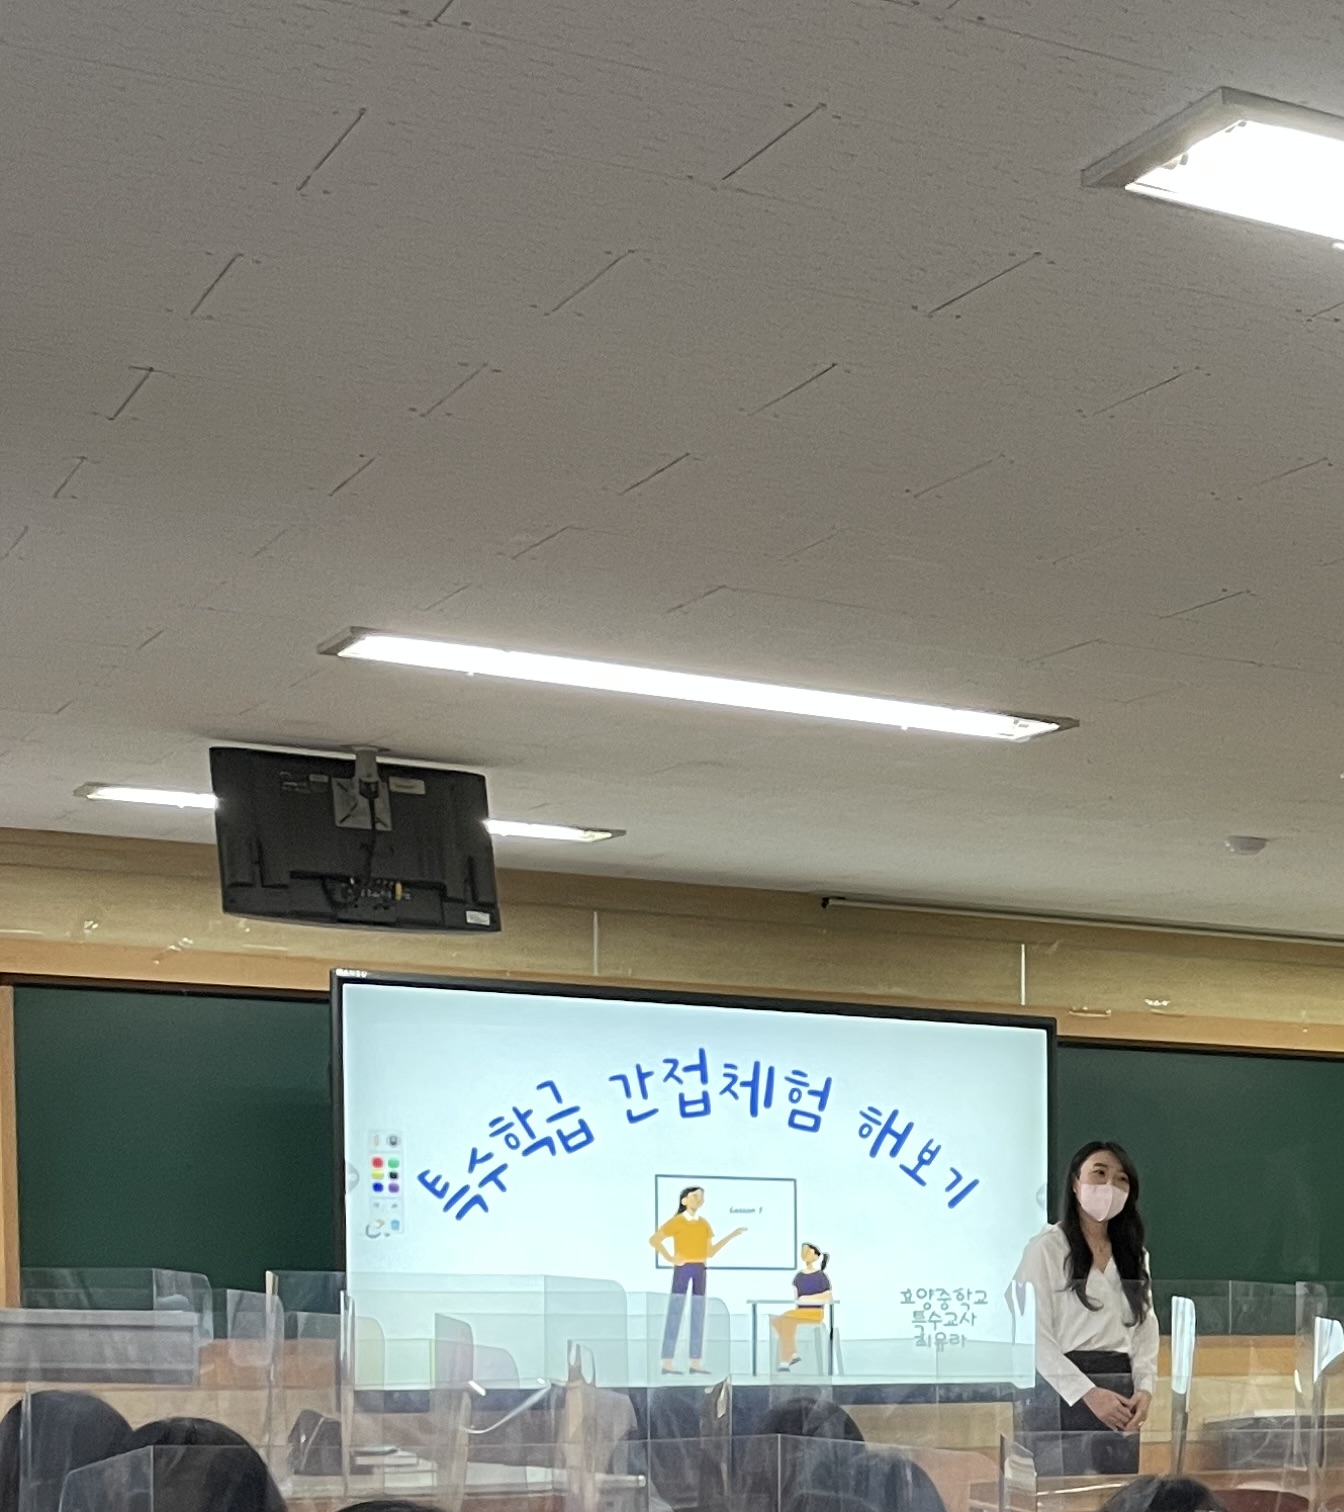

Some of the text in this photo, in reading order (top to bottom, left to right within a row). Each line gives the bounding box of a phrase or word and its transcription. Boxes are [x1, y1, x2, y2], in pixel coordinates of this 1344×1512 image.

[417, 1047, 980, 1221] 특수학급 간접체험 해보기
[911, 1310, 977, 1333] 특수교사
